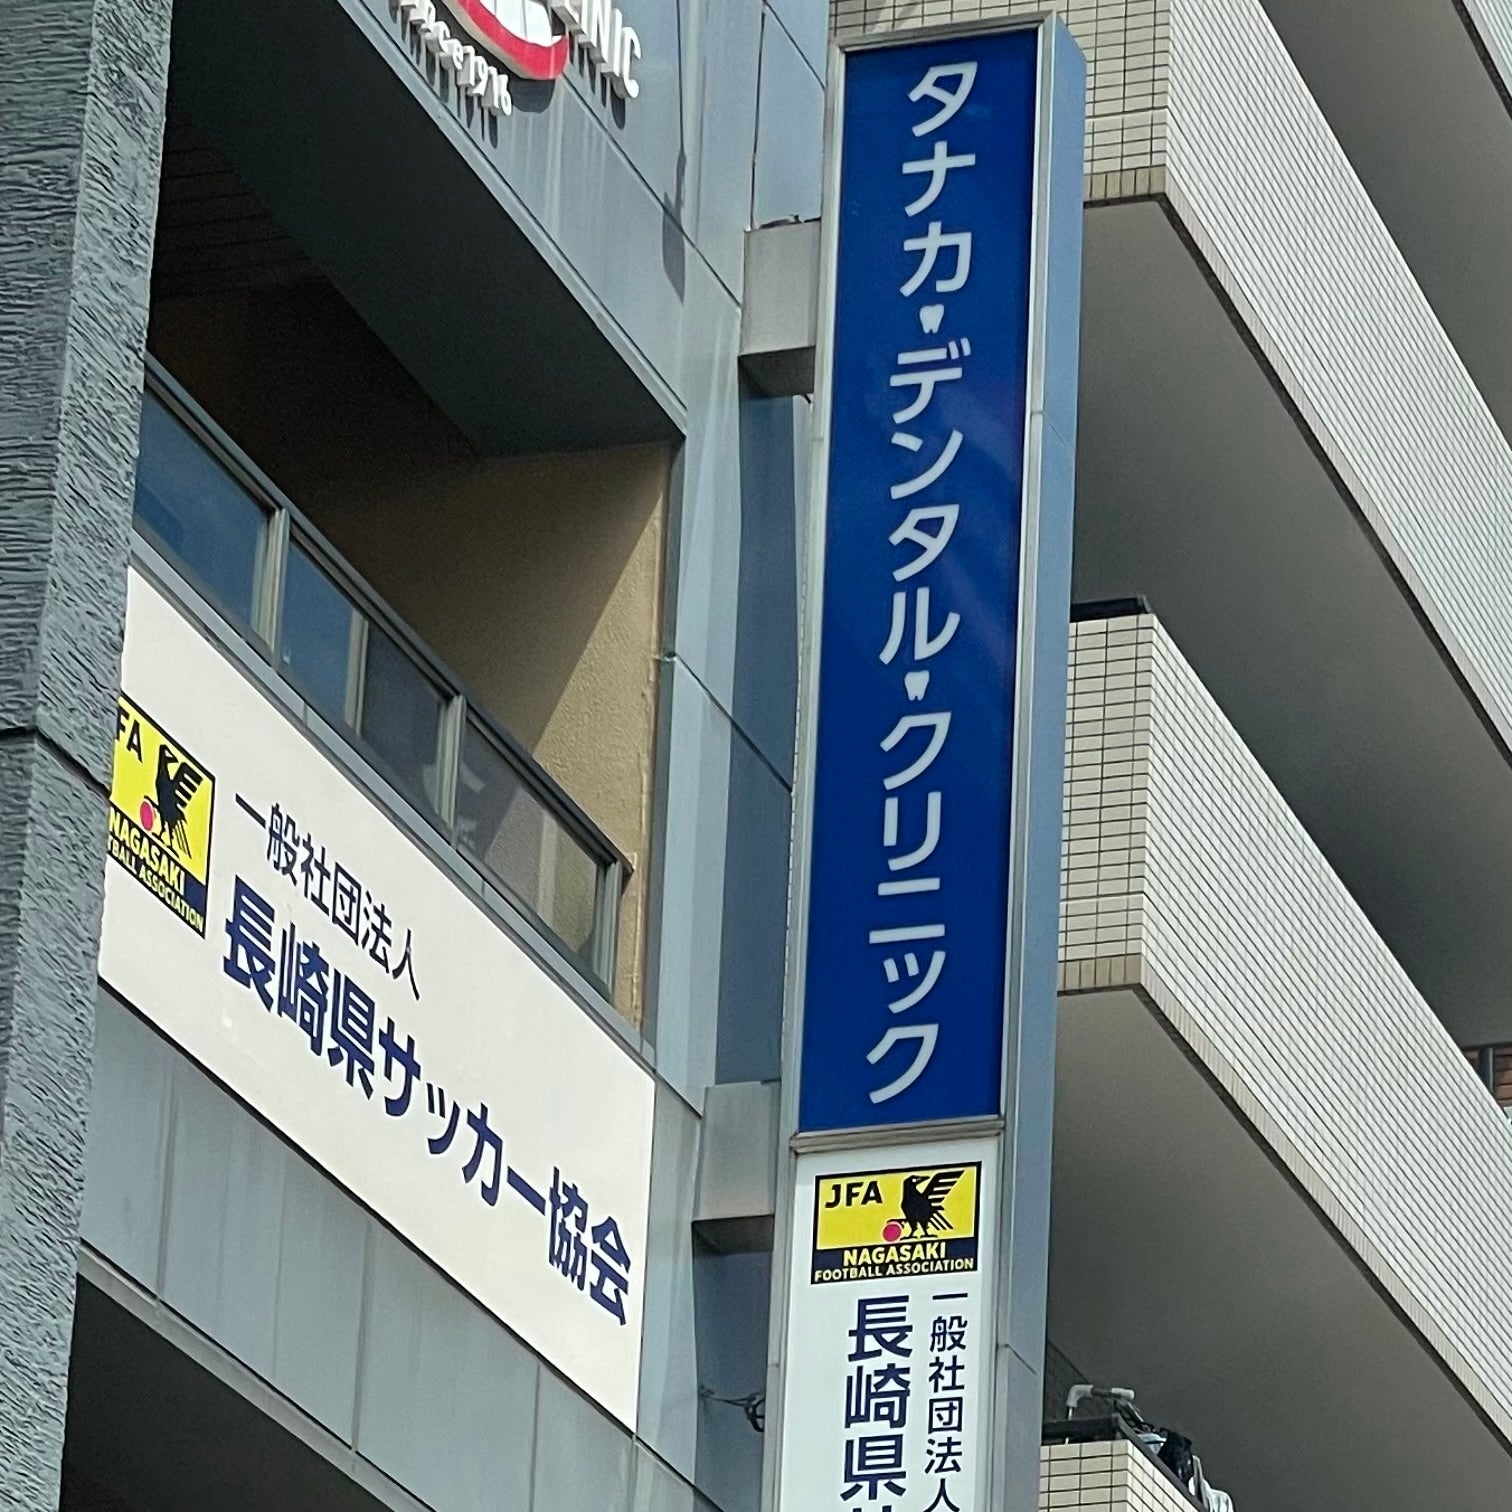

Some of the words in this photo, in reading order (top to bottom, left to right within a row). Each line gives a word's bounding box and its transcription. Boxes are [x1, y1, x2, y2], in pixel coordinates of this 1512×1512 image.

[115, 706, 143, 764] FA
[109, 806, 186, 896] NAGASAKI
[139, 865, 204, 933] ASSOCIATION
[235, 793, 420, 1001] 一般社団法人
[222, 873, 632, 1326] 長崎県サッカー協会
[825, 1180, 883, 1209] JFA
[814, 1266, 883, 1282] FOOTBALL
[886, 1258, 974, 1276] ASSOCIATION
[843, 1241, 946, 1266] NAGASAKI
